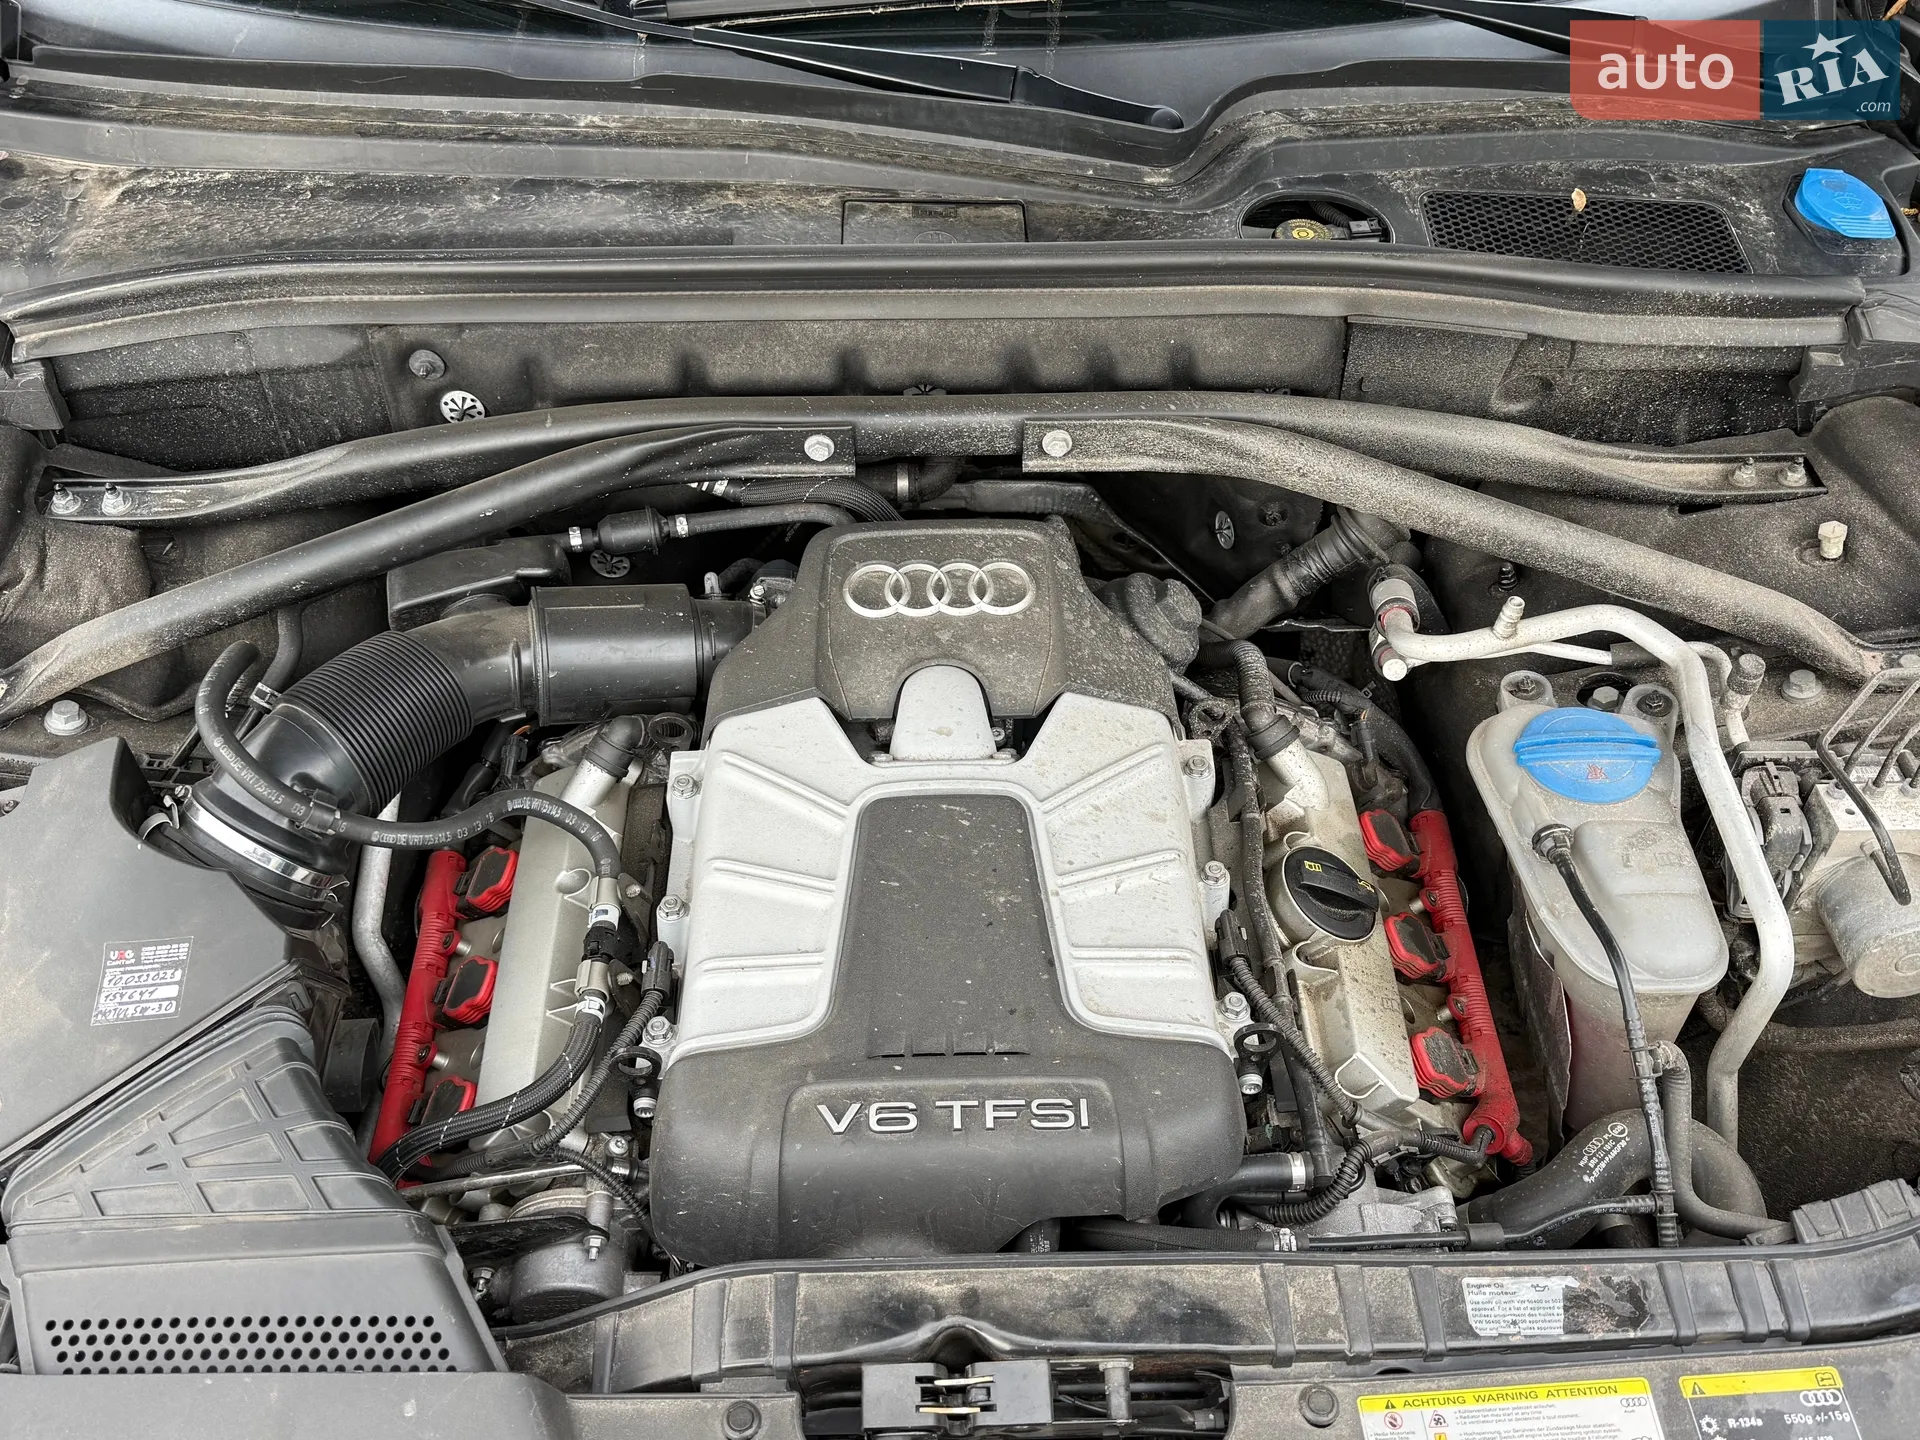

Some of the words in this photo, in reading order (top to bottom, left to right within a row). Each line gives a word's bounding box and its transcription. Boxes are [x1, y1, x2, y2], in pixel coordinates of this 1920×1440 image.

[816, 1100, 919, 1136] V6
[934, 1098, 1091, 1132] TFSI
[1402, 1395, 1466, 1408] ACHTUNG
[1472, 1390, 1539, 1403] WARNING
[1545, 1385, 1618, 1399] ATTENTION
[1727, 1417, 1763, 1429] R-134a
[1784, 1413, 1813, 1425] 550g
